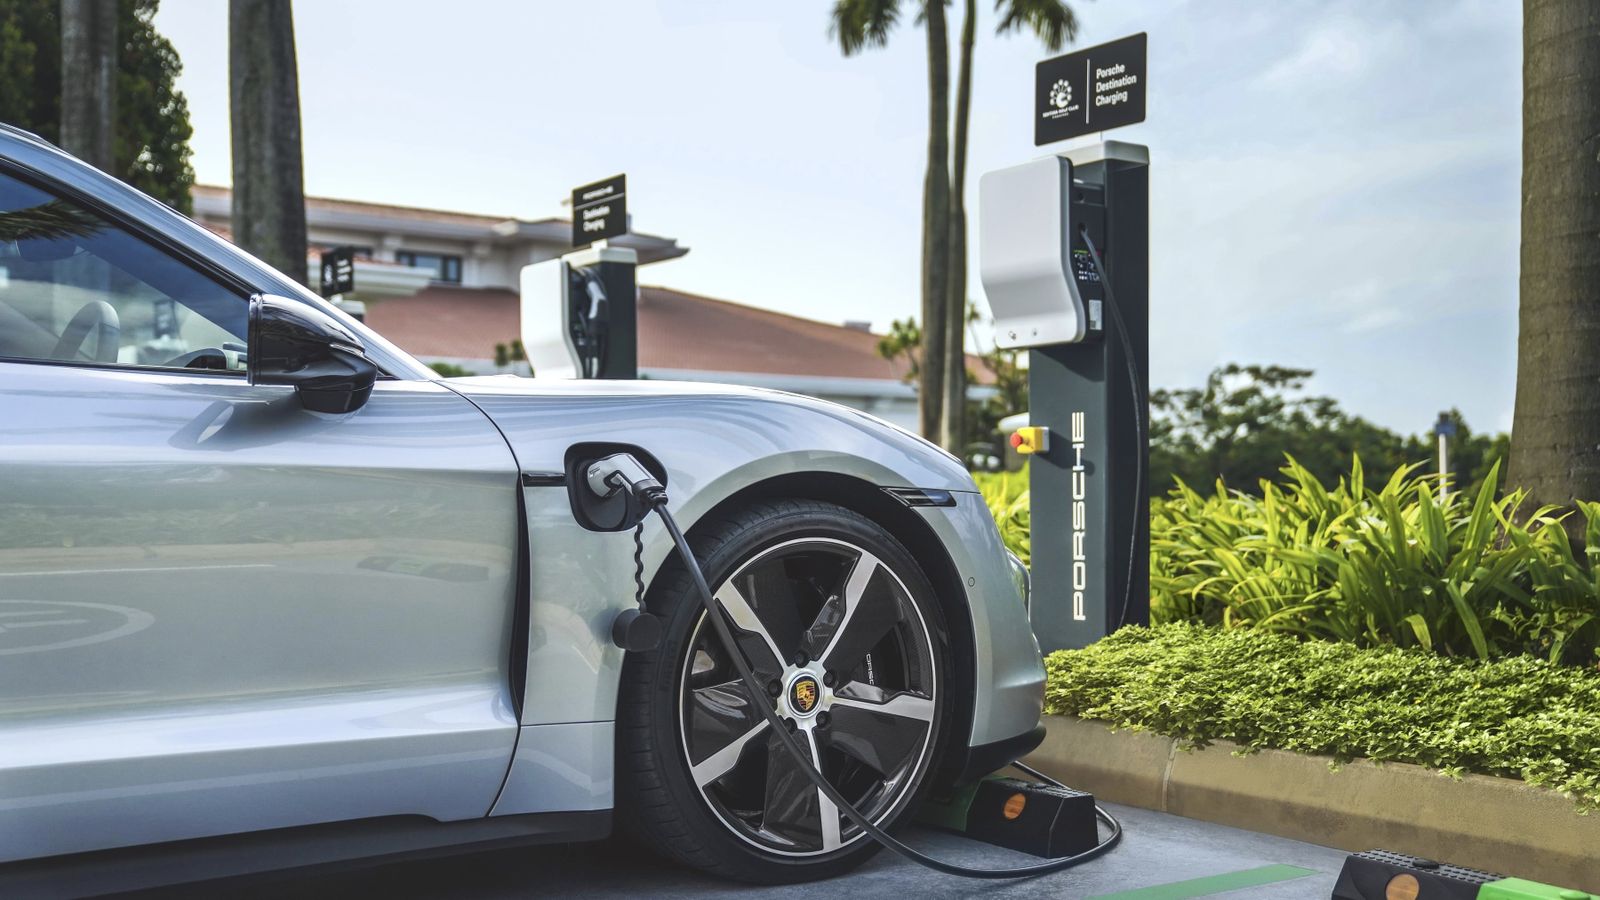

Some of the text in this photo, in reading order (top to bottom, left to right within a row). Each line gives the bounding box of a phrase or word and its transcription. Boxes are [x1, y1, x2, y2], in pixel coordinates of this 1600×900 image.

[1096, 63, 1125, 80] Porsche
[1096, 74, 1137, 93] Destination
[1096, 91, 1128, 107] Charging
[1072, 411, 1086, 620] PORSCHE
[866, 653, 874, 685] ORSC
